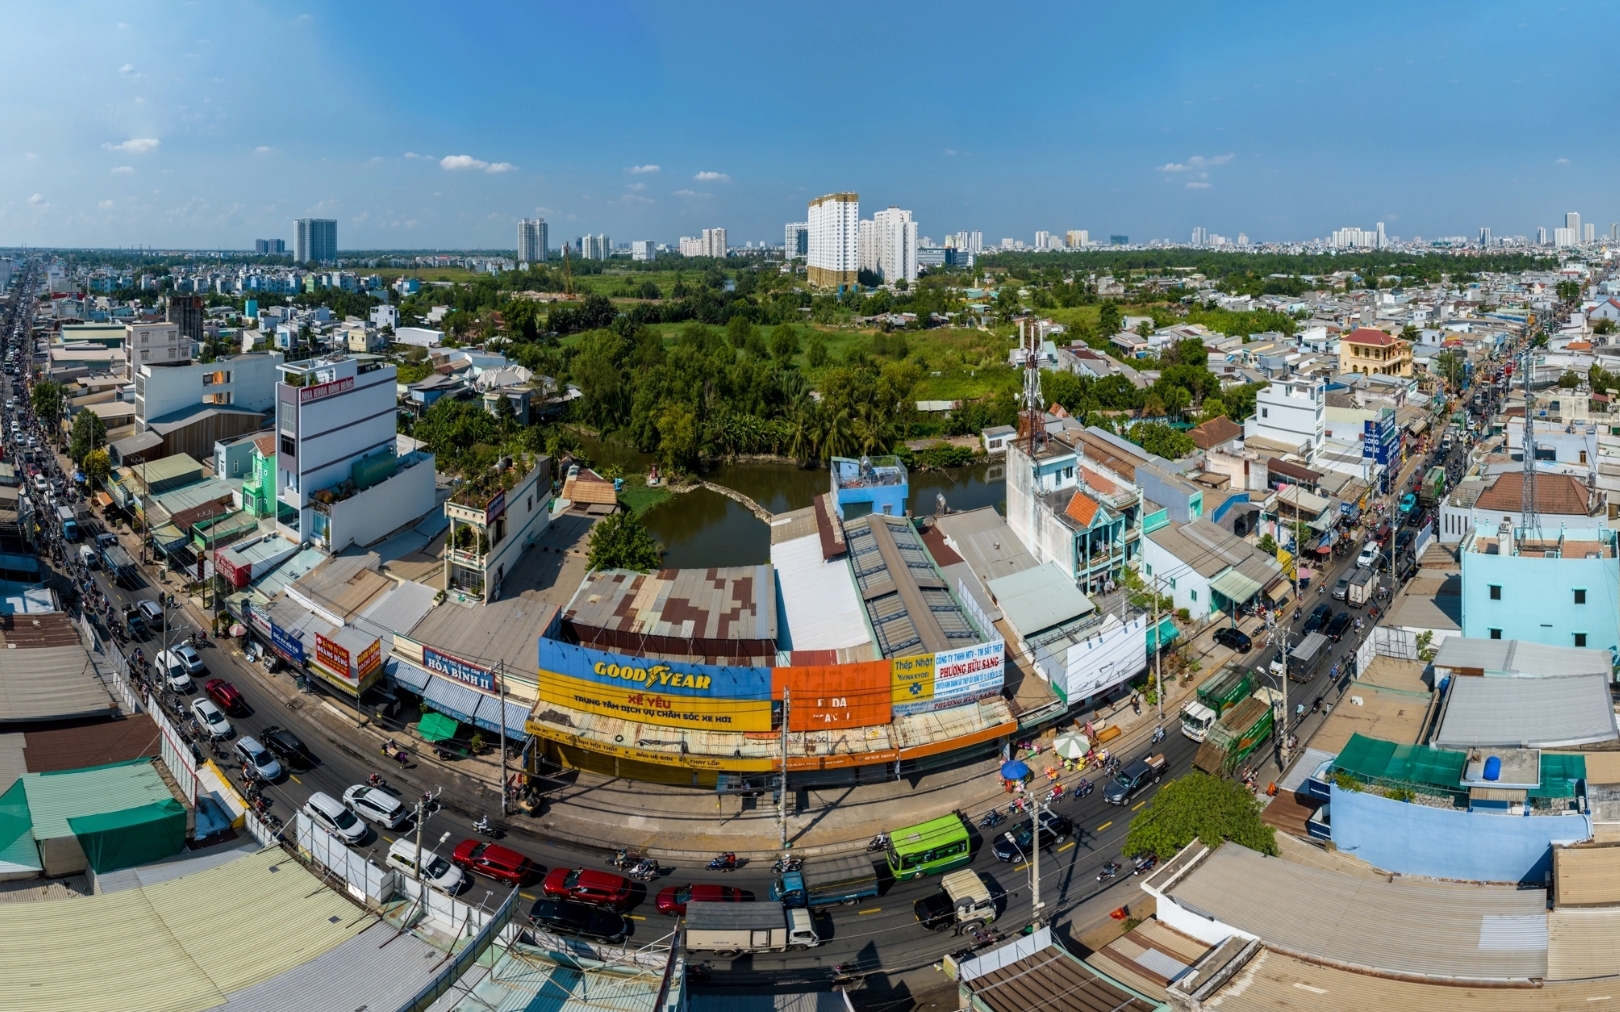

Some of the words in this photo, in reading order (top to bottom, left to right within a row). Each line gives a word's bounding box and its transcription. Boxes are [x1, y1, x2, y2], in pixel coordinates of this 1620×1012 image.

[314, 385, 327, 398] KHOA
[895, 660, 912, 671] Thép
[916, 657, 933, 668] Nhật
[936, 654, 947, 664] CÔNG
[966, 650, 974, 659] MTV
[428, 658, 450, 674] HÒA
[451, 666, 478, 685] BÌNH
[480, 678, 489, 689] II
[939, 664, 966, 678] PHƯƠNG
[968, 659, 981, 673] HỮU
[982, 657, 999, 670] SANG
[628, 693, 644, 706] XẾ
[647, 696, 671, 709] YÊU
[979, 690, 997, 699] SANG
[574, 695, 601, 706] TRUNG
[602, 701, 619, 710] TÂM
[620, 705, 641, 714] DỊCH
[643, 709, 654, 718] VỤ
[656, 709, 681, 719] CHĂM
[683, 712, 699, 721] SÓC
